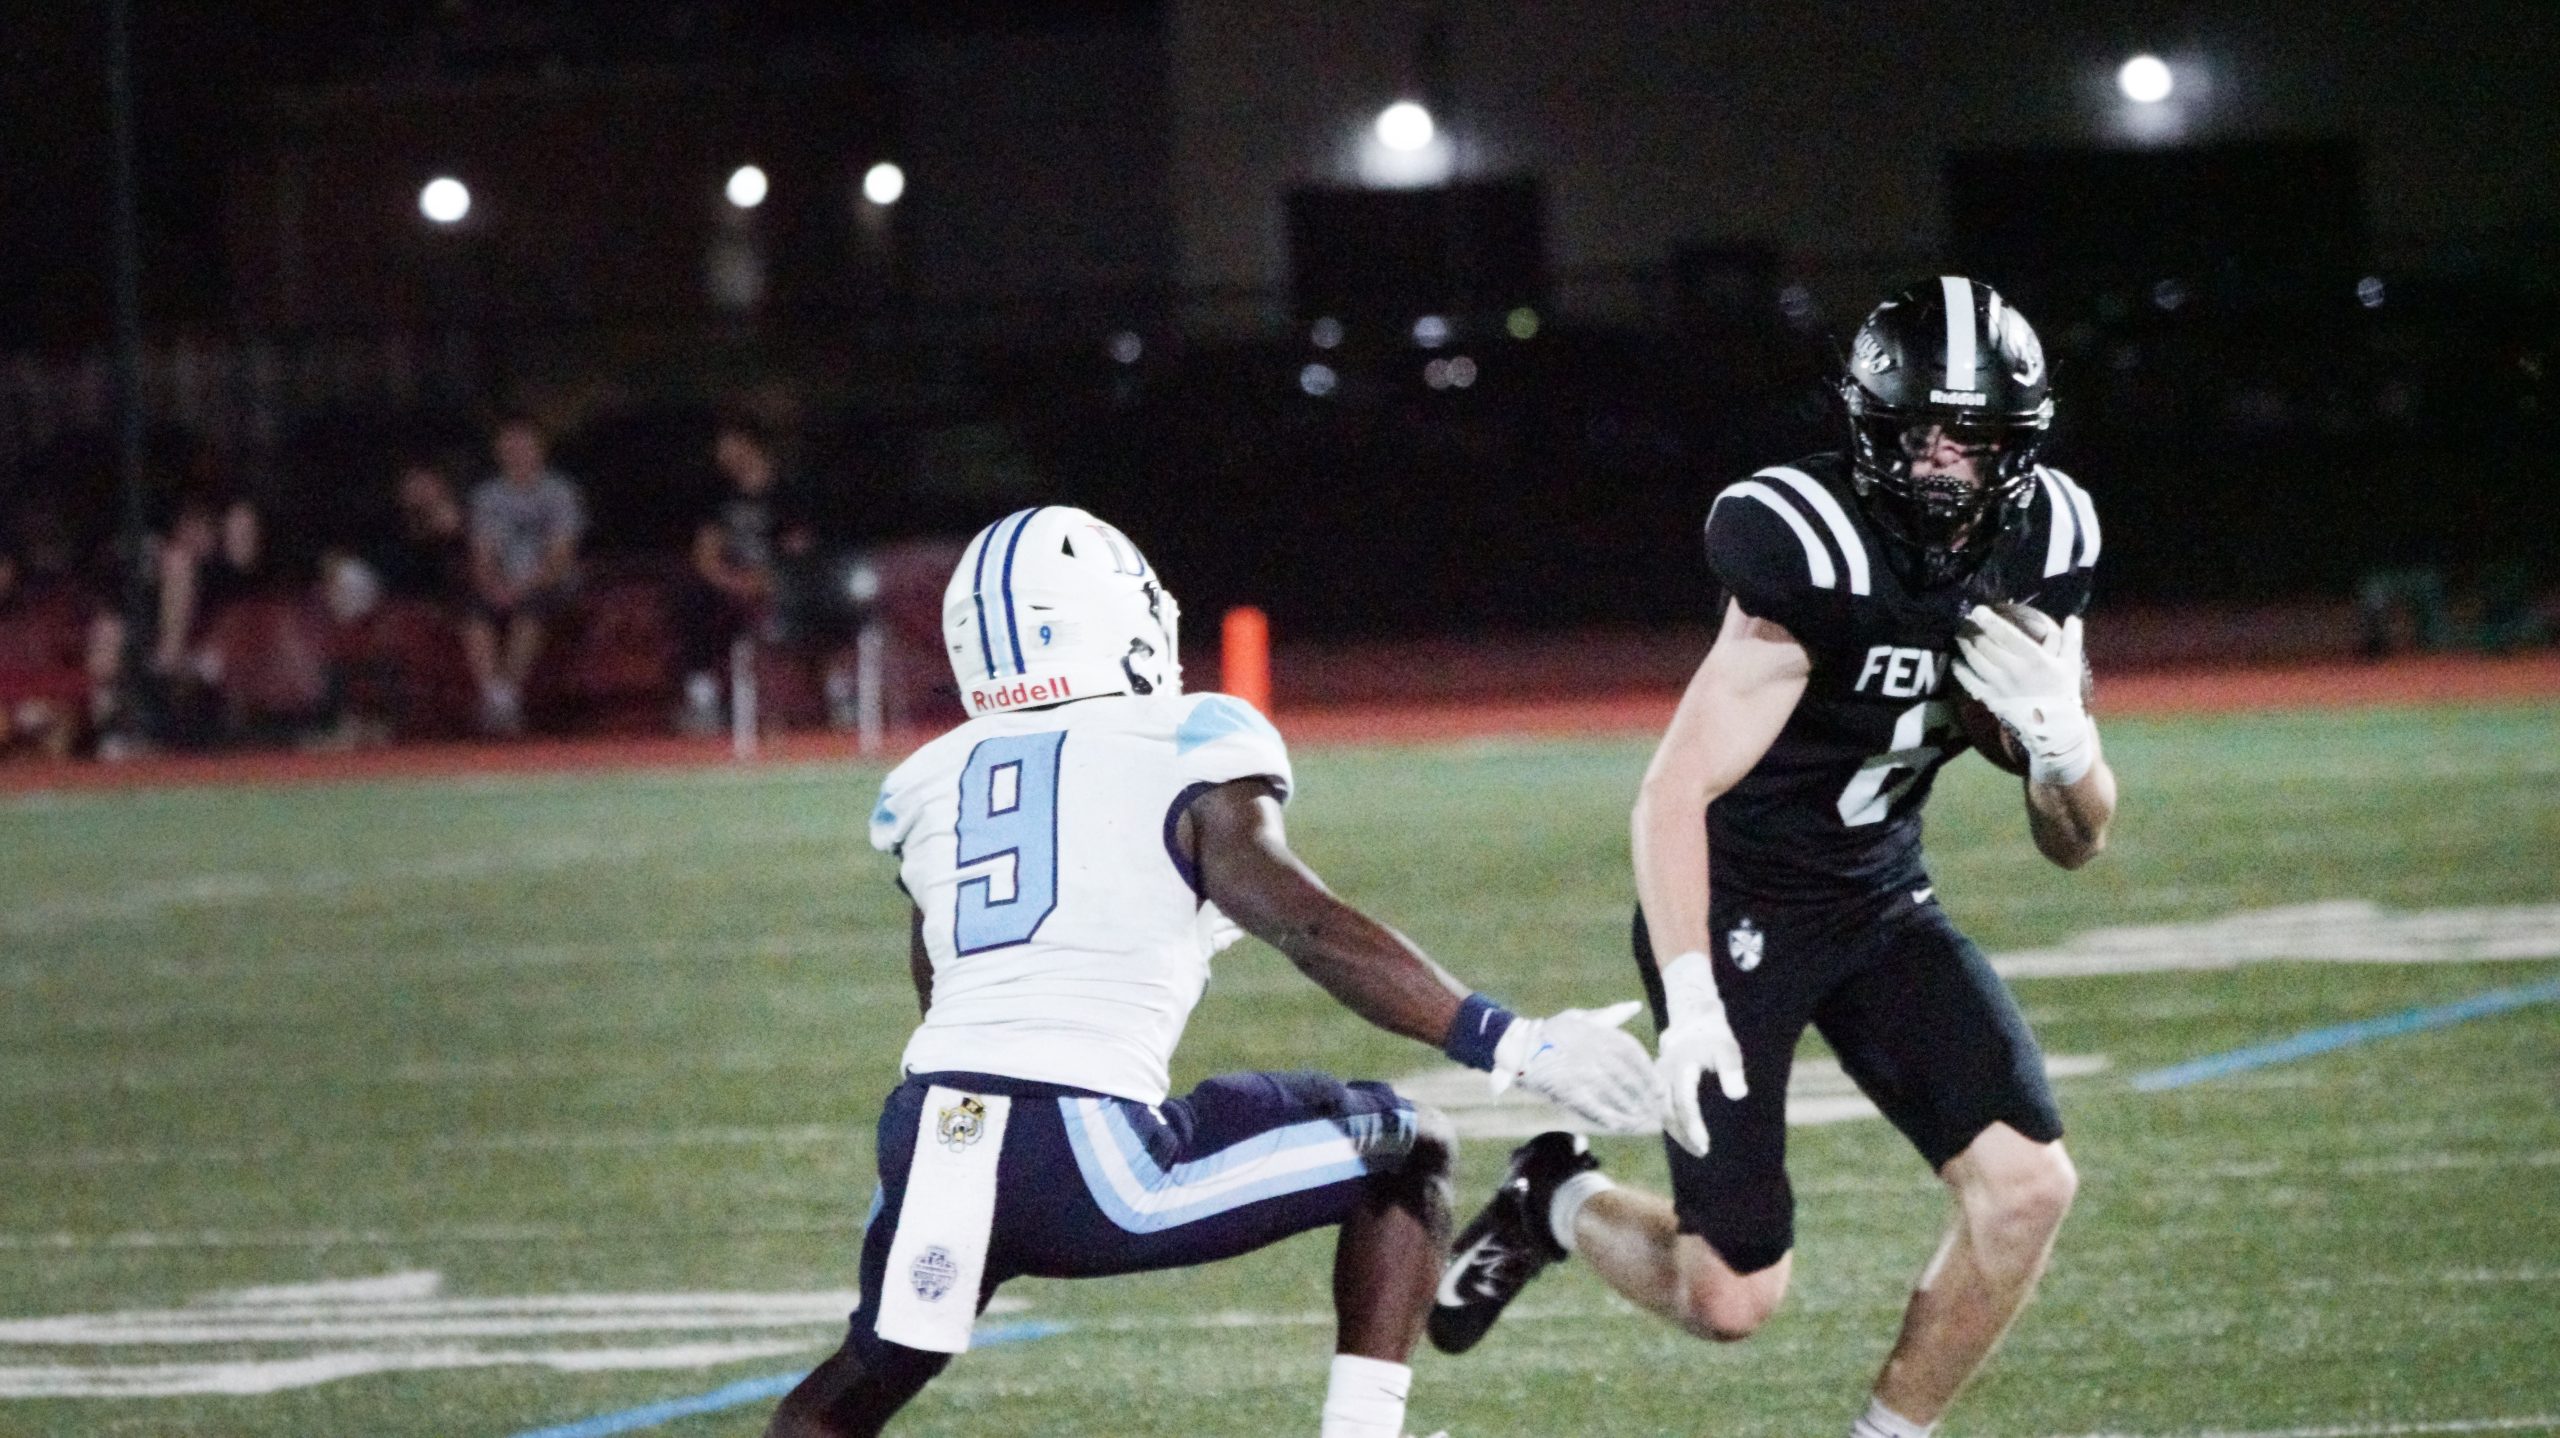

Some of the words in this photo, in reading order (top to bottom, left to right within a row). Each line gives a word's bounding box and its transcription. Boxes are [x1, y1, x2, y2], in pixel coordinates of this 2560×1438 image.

[1039, 625, 1052, 646] 9
[972, 676, 1071, 712] Riddell
[954, 729, 1068, 958] 9
